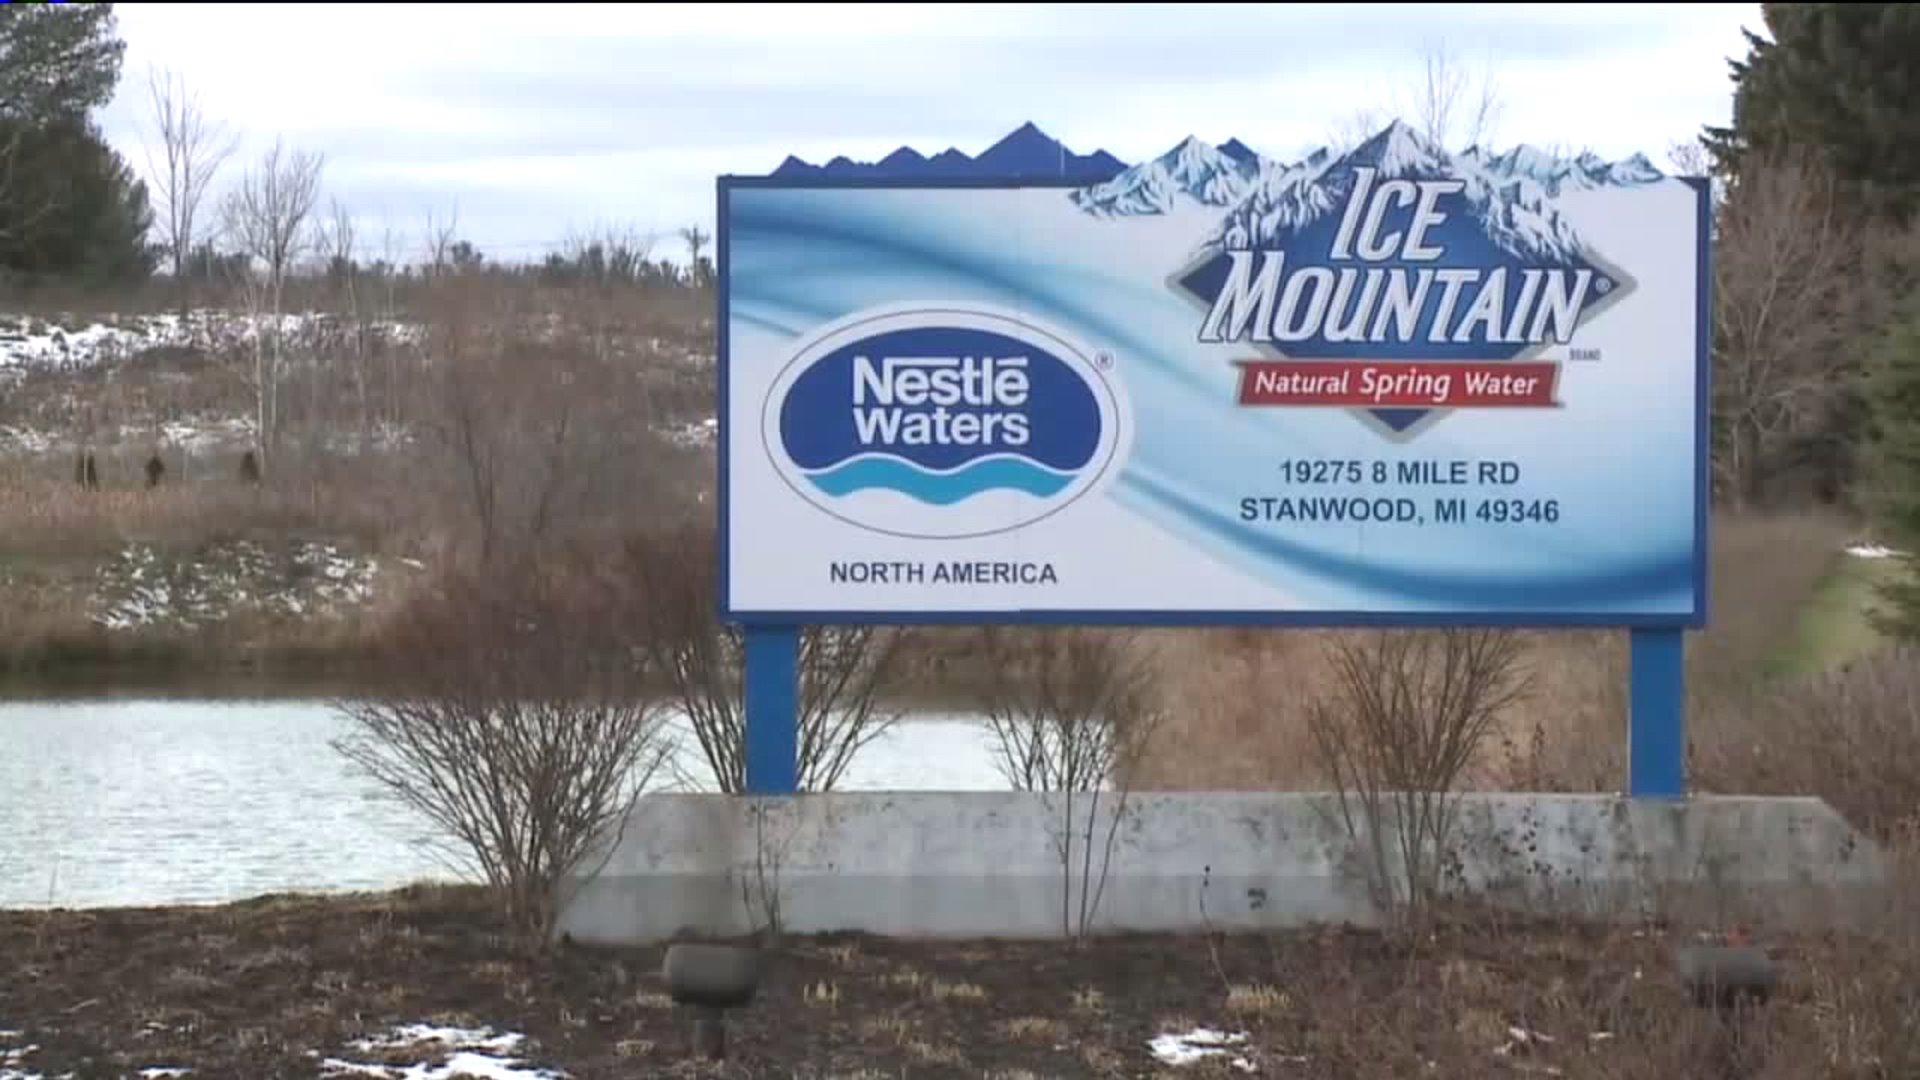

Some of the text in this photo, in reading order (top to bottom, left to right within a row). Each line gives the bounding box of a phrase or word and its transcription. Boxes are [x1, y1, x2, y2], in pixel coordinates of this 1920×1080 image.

[1330, 166, 1465, 261] ICE
[1199, 250, 1592, 344] MOUNTAIN
[1254, 367, 1538, 402] Natural Spring Water
[853, 408, 1030, 445] Waters
[1280, 460, 1520, 484] 19275 8 MILE RD
[1240, 497, 1560, 527] STANWOOD, MI 49346
[830, 562, 1058, 584] NORTH AMERICA
